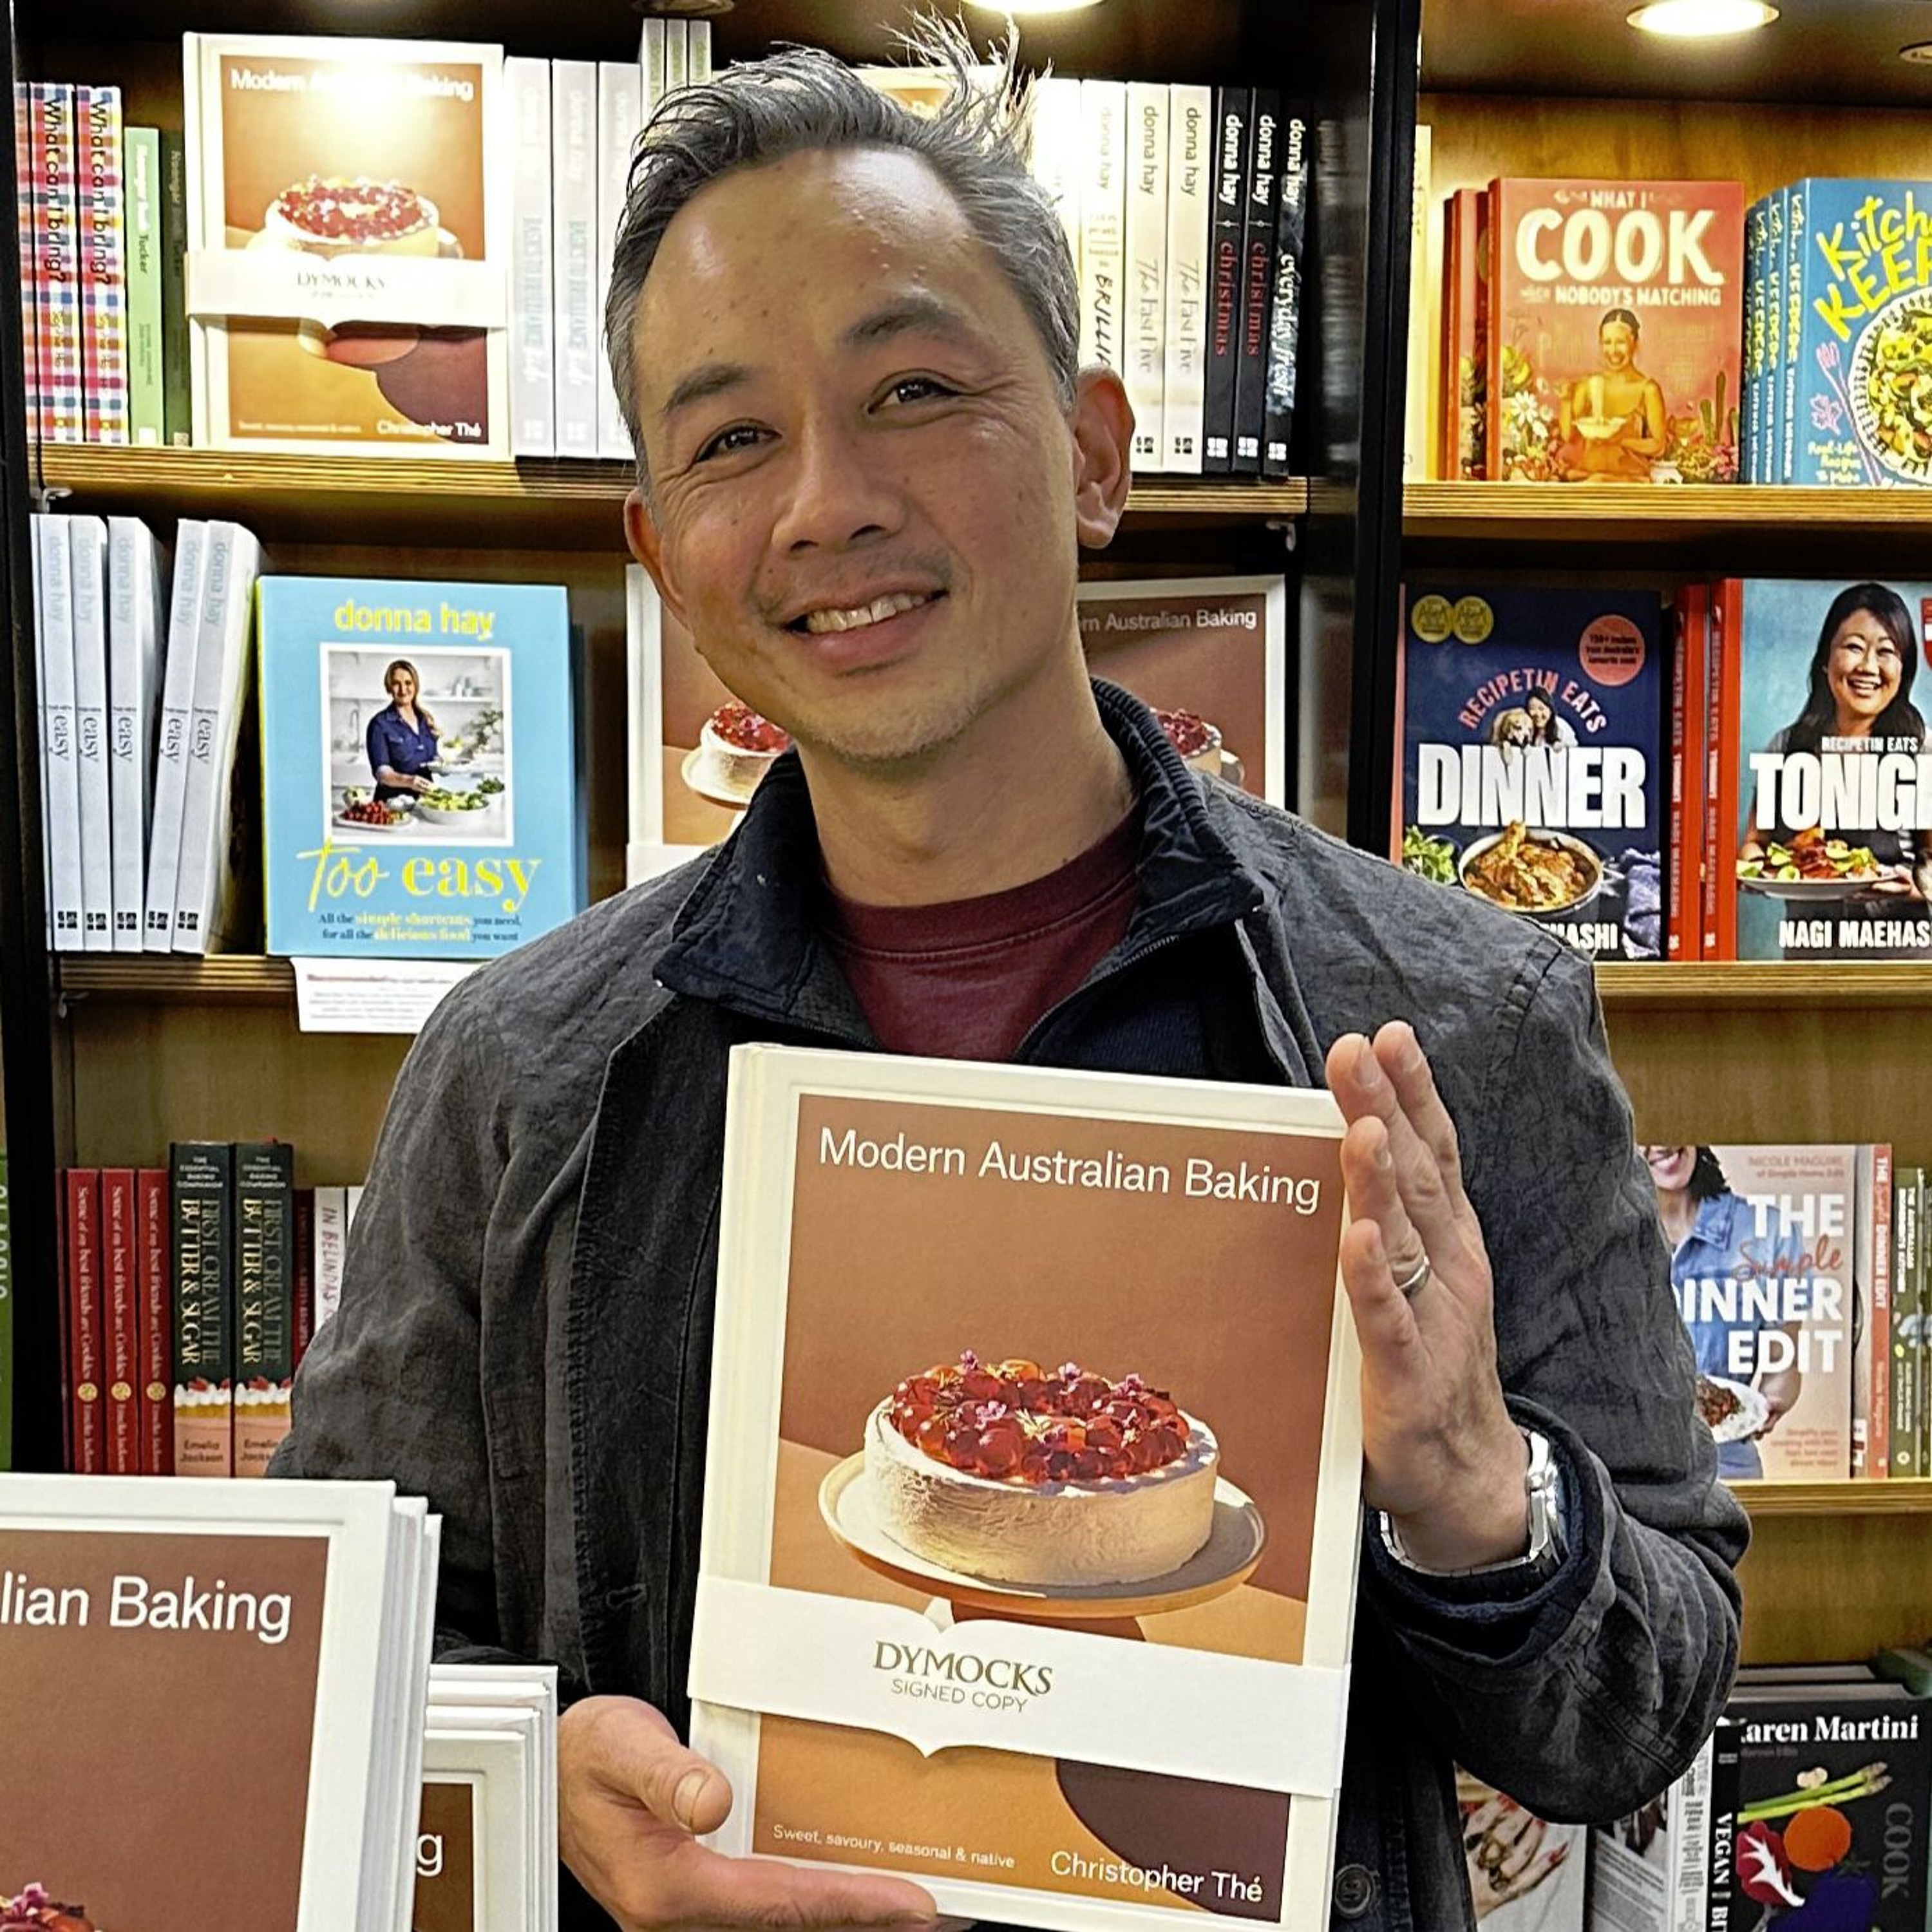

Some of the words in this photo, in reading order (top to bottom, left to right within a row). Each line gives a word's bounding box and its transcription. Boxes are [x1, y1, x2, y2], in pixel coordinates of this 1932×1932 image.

[43, 100, 61, 156] What
[90, 101, 108, 156] What
[1144, 106, 1160, 160] donna
[1186, 106, 1202, 162] donna
[1224, 114, 1243, 172] donna
[1258, 114, 1277, 172] donna
[1287, 118, 1307, 172] donna
[46, 161, 59, 200] can
[91, 164, 105, 204] can
[1139, 164, 1159, 195] hay
[1180, 166, 1200, 197] hay
[1218, 175, 1241, 206] hay
[1252, 175, 1274, 206] hay
[1282, 175, 1304, 206] hay
[1590, 191, 1636, 209] WHAT
[44, 217, 65, 283] bring?
[90, 221, 112, 285] bring?
[137, 234, 150, 274] Tucker
[1516, 207, 1726, 286] COOK
[1816, 191, 1932, 281] Kitch
[1136, 258, 1160, 292] The
[1176, 259, 1200, 295] The
[1271, 254, 1296, 341] everyday
[1555, 285, 1633, 306] NOBODY'S
[1140, 298, 1159, 331] Fast
[1180, 299, 1200, 332] Fast
[1215, 242, 1236, 356] christmas
[1247, 242, 1270, 356] christmas
[1269, 340, 1294, 397] fresh
[48, 536, 62, 589] donna
[79, 537, 95, 590] donna
[117, 537, 133, 589] donna
[181, 541, 198, 592] donna
[211, 541, 229, 592] donna
[47, 592, 65, 623] hay
[77, 594, 96, 625] hay
[116, 594, 134, 624] hay
[176, 596, 196, 627] hay
[204, 598, 225, 628] hay
[334, 600, 432, 632] donna
[440, 603, 495, 641] hay
[1105, 612, 1190, 631] Australian
[1196, 609, 1256, 630] Baking
[1458, 667, 1559, 730] RECIPETIN
[1562, 680, 1607, 734] EATS
[48, 715, 70, 762] easy
[78, 717, 99, 763] easy
[113, 716, 135, 763] easy
[160, 717, 185, 764] easy
[190, 717, 213, 764] easy
[1822, 737, 1883, 752] RECIPETIN
[1887, 737, 1918, 752] EATS
[1417, 743, 1647, 828] DINNER
[402, 856, 542, 913] easy
[319, 913, 336, 924] All
[337, 913, 354, 924] the
[473, 916, 492, 927] you
[322, 927, 338, 939] for
[339, 928, 355, 940] all
[355, 928, 374, 940] the
[472, 932, 491, 943] you
[493, 932, 519, 942] want
[1778, 920, 1833, 950] NAGI
[1839, 921, 1932, 949] MAEHAS
[819, 1126, 965, 1176] Modern
[978, 1141, 1171, 1194] Australian
[1184, 1158, 1321, 1215] Baking
[1875, 1157, 1889, 1183] THE
[180, 1198, 201, 1277] BUTTER
[242, 1198, 263, 1276] BUTTER
[322, 1206, 338, 1225] IN
[1747, 1193, 1844, 1237] THE
[1736, 1233, 1842, 1283] Simple
[1875, 1224, 1888, 1276] DINNER
[181, 1279, 200, 1295] &
[243, 1279, 262, 1294] &
[1672, 1278, 1842, 1322] INNER
[1875, 1277, 1888, 1309] EDIT
[180, 1298, 201, 1365] SUGAR
[242, 1298, 263, 1365] SUGAR
[1728, 1331, 1842, 1374] EDIT
[109, 1575, 292, 1645] Baking
[873, 1640, 1054, 1697] DYMOCKS
[891, 1678, 965, 1705] SIGNED
[971, 1691, 1028, 1713] COPY
[1739, 1716, 1809, 1743] aren
[1814, 1714, 1919, 1741] Martini
[772, 1824, 823, 1845] Sweet,
[826, 1833, 885, 1855] savoury,
[888, 1841, 952, 1861] seasonal
[956, 1846, 967, 1862] &
[971, 1851, 1016, 1869] native
[1713, 1812, 1733, 1884] VEGAN
[1881, 1803, 1914, 1899] COOK
[1050, 1850, 1205, 1895] Christopher
[1211, 1871, 1264, 1904] Thé
